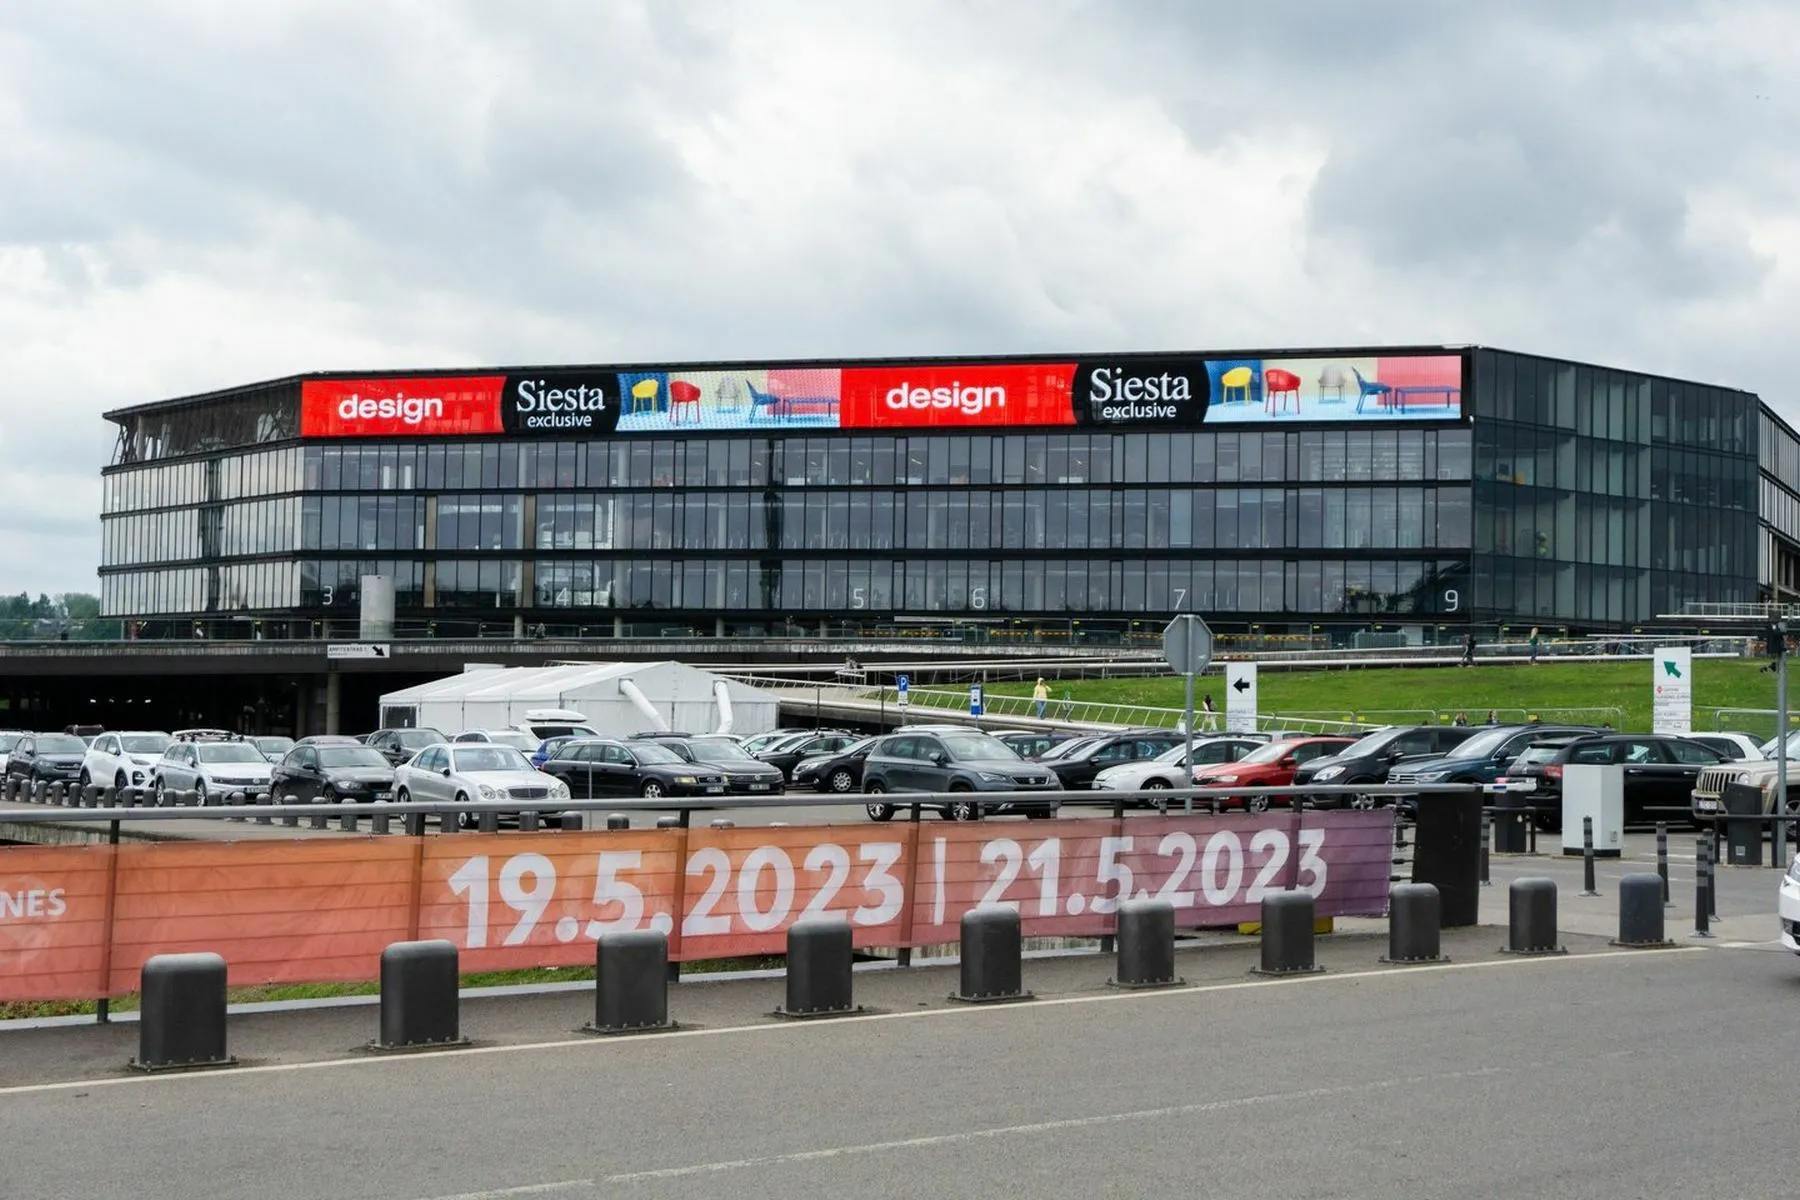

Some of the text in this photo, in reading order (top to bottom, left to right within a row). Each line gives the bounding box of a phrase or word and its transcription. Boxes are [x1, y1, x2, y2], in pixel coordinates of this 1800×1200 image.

[1090, 368, 1191, 401] Siesta
[516, 380, 605, 412] Siesta
[886, 381, 1005, 414] design
[338, 393, 442, 424] design
[1103, 402, 1176, 419] exclusive
[527, 412, 592, 428] exclusive
[322, 585, 333, 605] 3
[556, 587, 569, 606] 4
[853, 588, 864, 609] 5
[972, 588, 985, 609] 6
[1173, 588, 1186, 610] 7
[1445, 589, 1459, 612] 9
[448, 842, 905, 948] 19.5.2023
[976, 828, 1327, 916] 21.5.2023
[0, 888, 66, 918] NES
